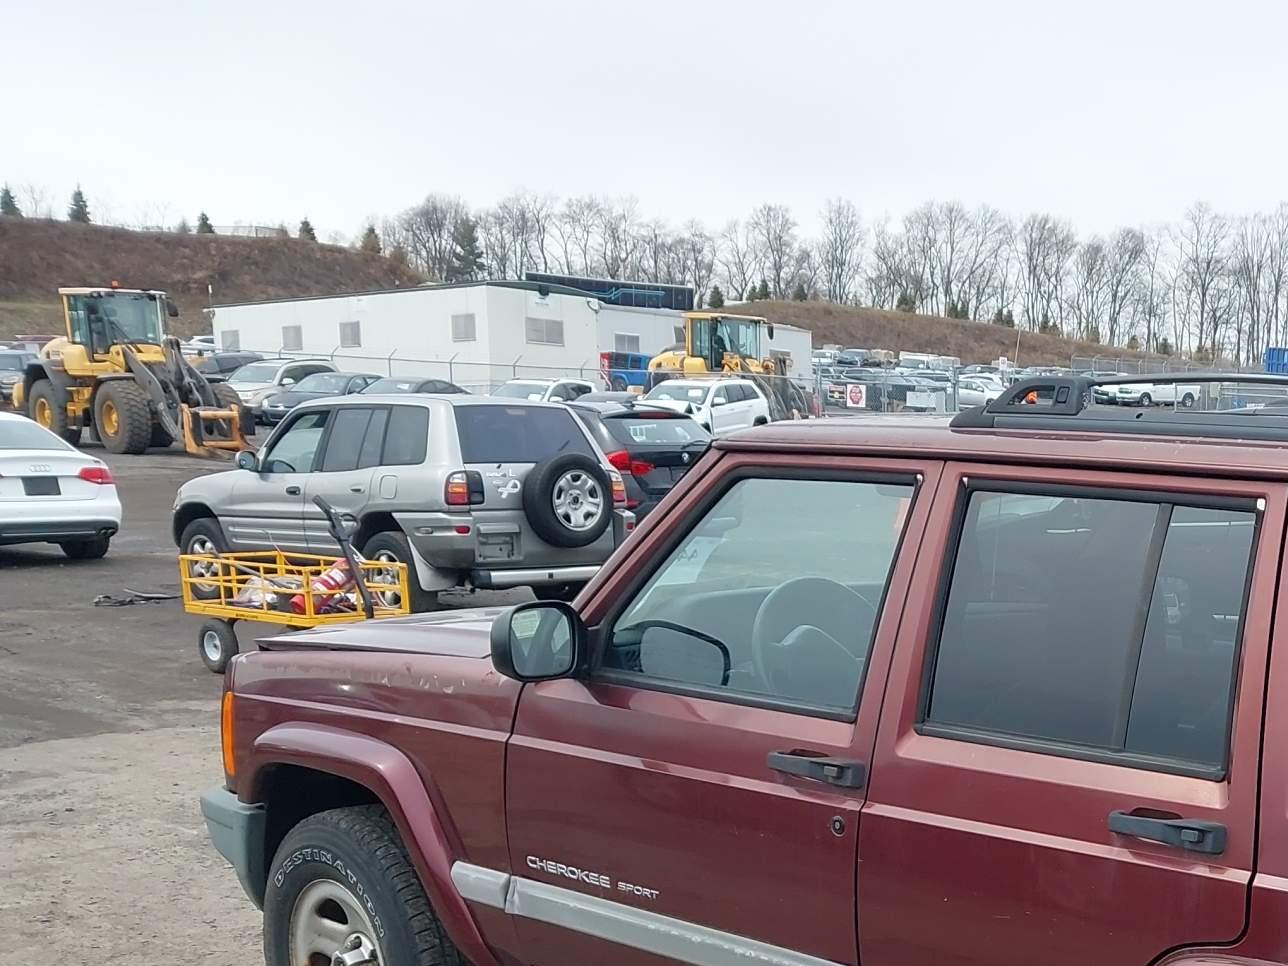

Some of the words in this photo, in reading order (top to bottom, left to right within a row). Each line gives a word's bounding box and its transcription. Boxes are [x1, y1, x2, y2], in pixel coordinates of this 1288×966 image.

[274, 848, 385, 938] DESTINATION
[526, 855, 611, 888] CHEROKEE
[616, 881, 660, 900] SPORT
